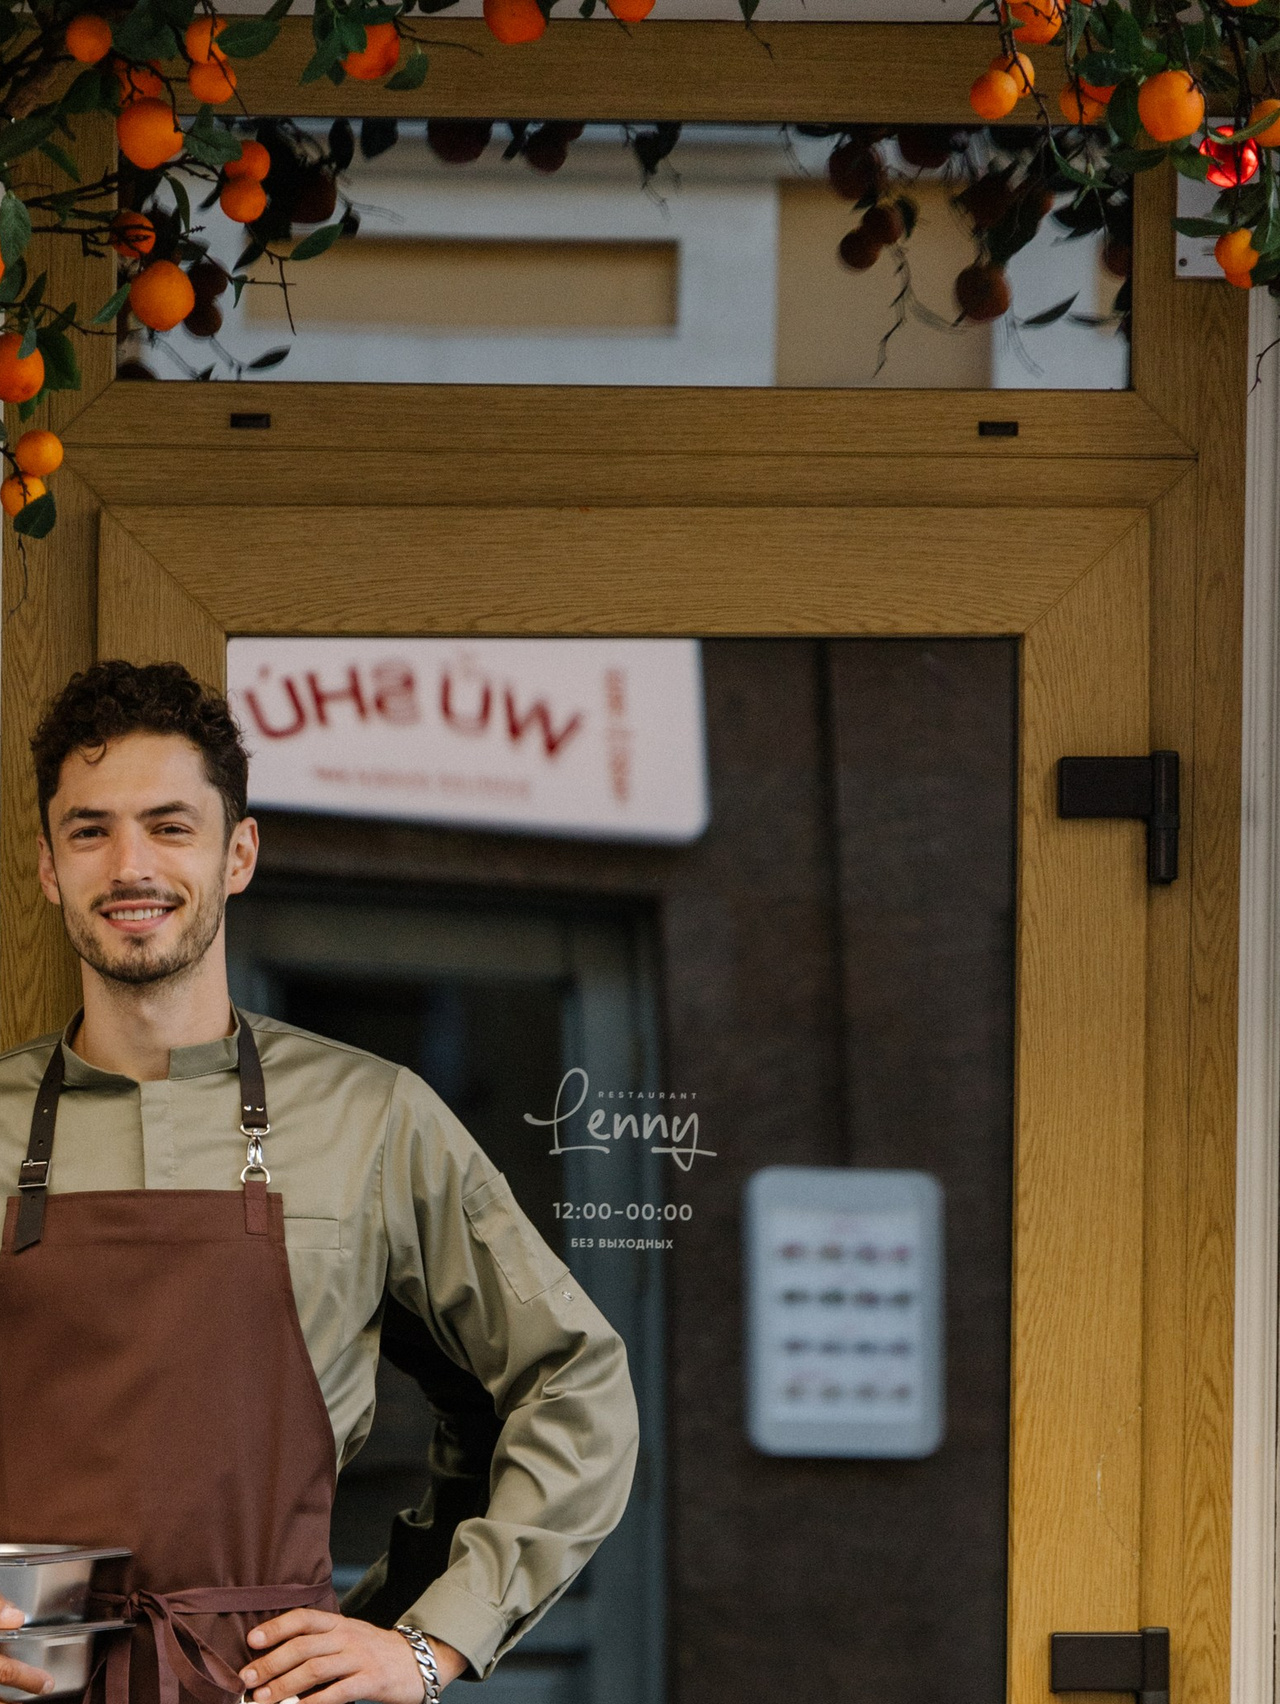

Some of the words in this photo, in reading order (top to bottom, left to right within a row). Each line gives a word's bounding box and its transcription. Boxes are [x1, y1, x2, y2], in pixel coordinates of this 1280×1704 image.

[598, 1091, 698, 1100] RESTAURANT
[523, 1067, 718, 1172] Lenny
[570, 1237, 595, 1249] БЕЗ
[598, 1238, 674, 1251] ВЫХОДНЫХ
